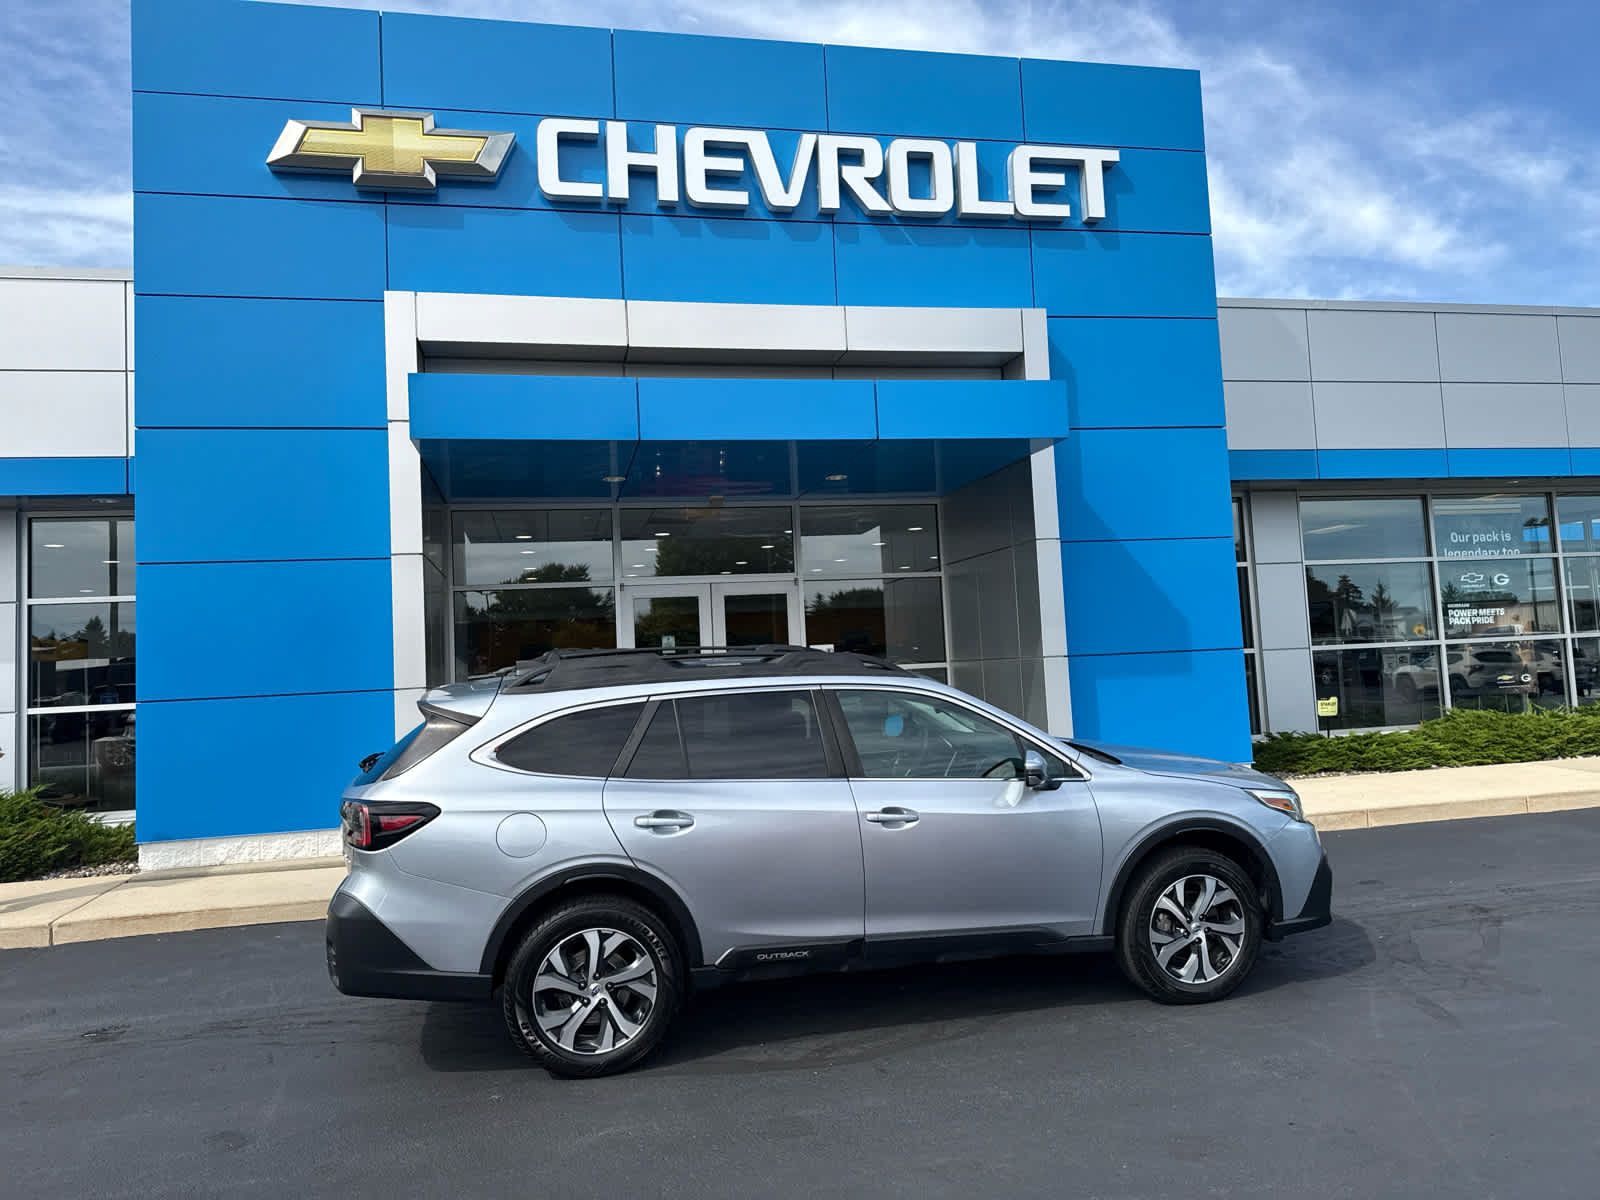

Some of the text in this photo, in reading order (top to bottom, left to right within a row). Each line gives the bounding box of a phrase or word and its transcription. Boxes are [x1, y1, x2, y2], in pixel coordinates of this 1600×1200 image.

[537, 117, 1120, 223] CHEVROLET
[1450, 530, 1512, 545] Our pack is
[1448, 607, 1505, 618] POWER MEETS
[1449, 615, 1495, 625] PACK PRIDE
[756, 950, 810, 961] OUTBACK
